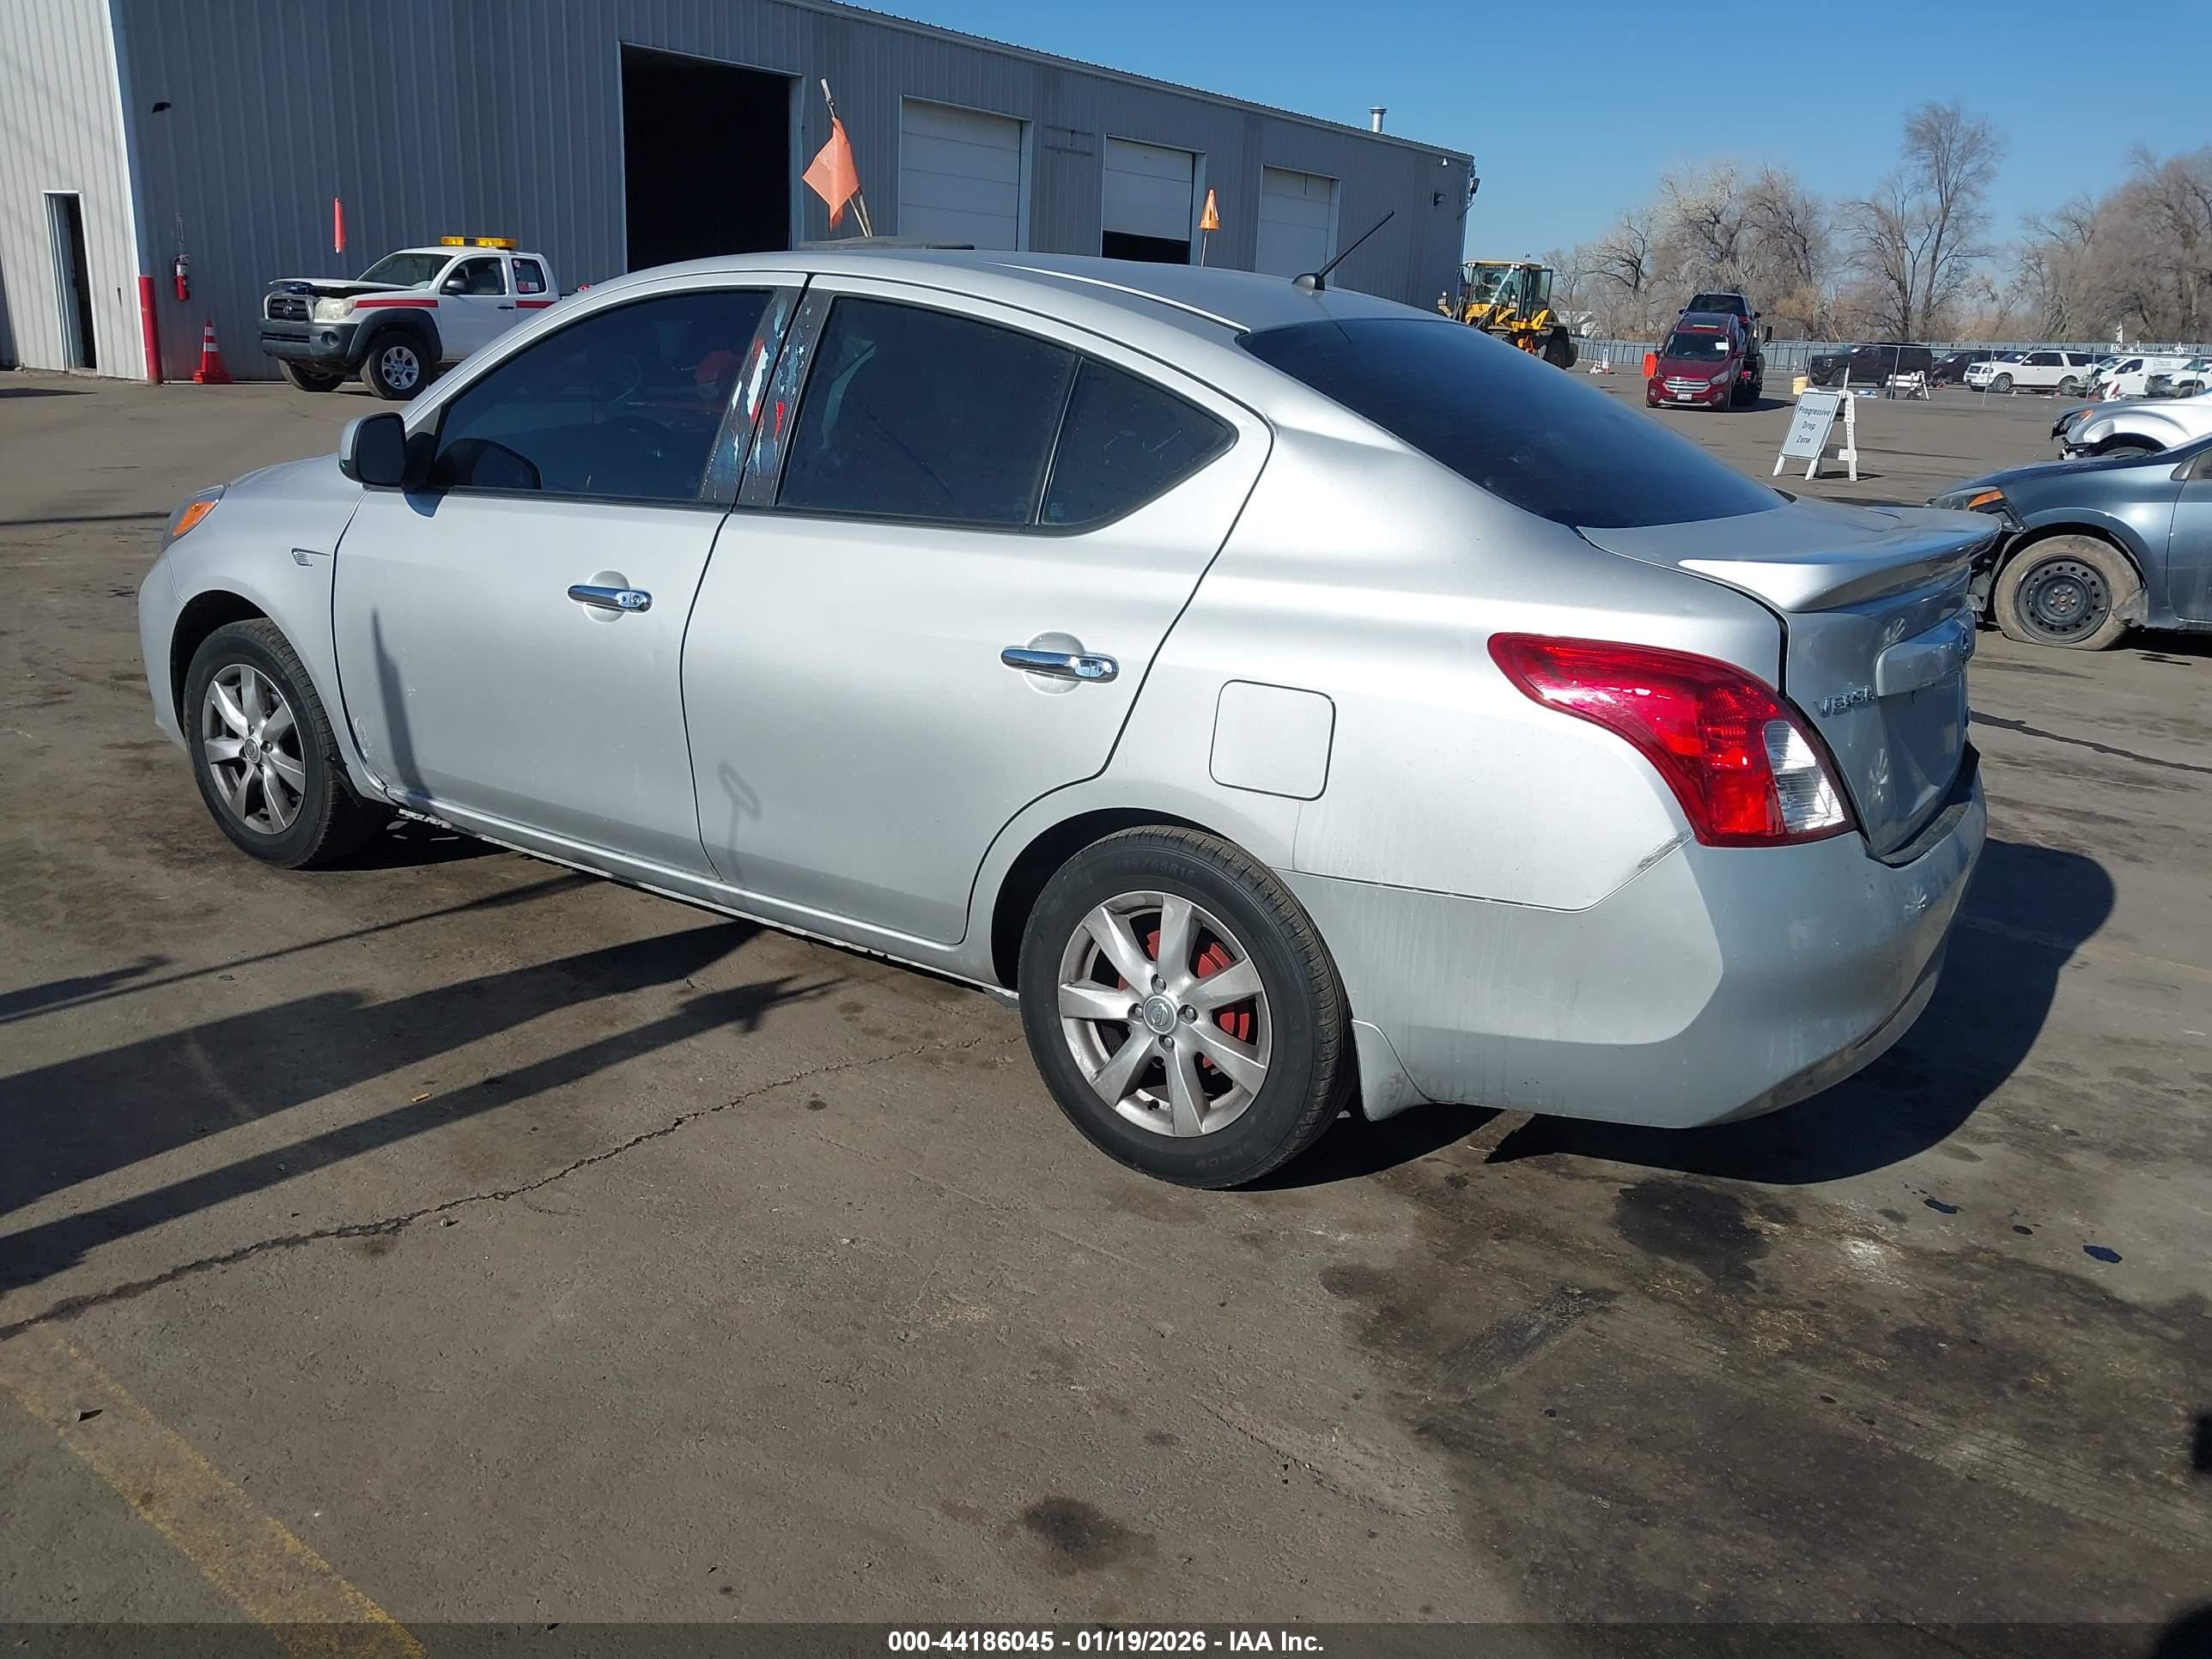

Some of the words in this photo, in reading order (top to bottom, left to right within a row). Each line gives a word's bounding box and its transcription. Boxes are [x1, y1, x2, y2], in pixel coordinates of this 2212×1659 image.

[1798, 405, 1831, 416] Progressive
[1802, 421, 1816, 431] Drop
[1796, 434, 1811, 443] Zone
